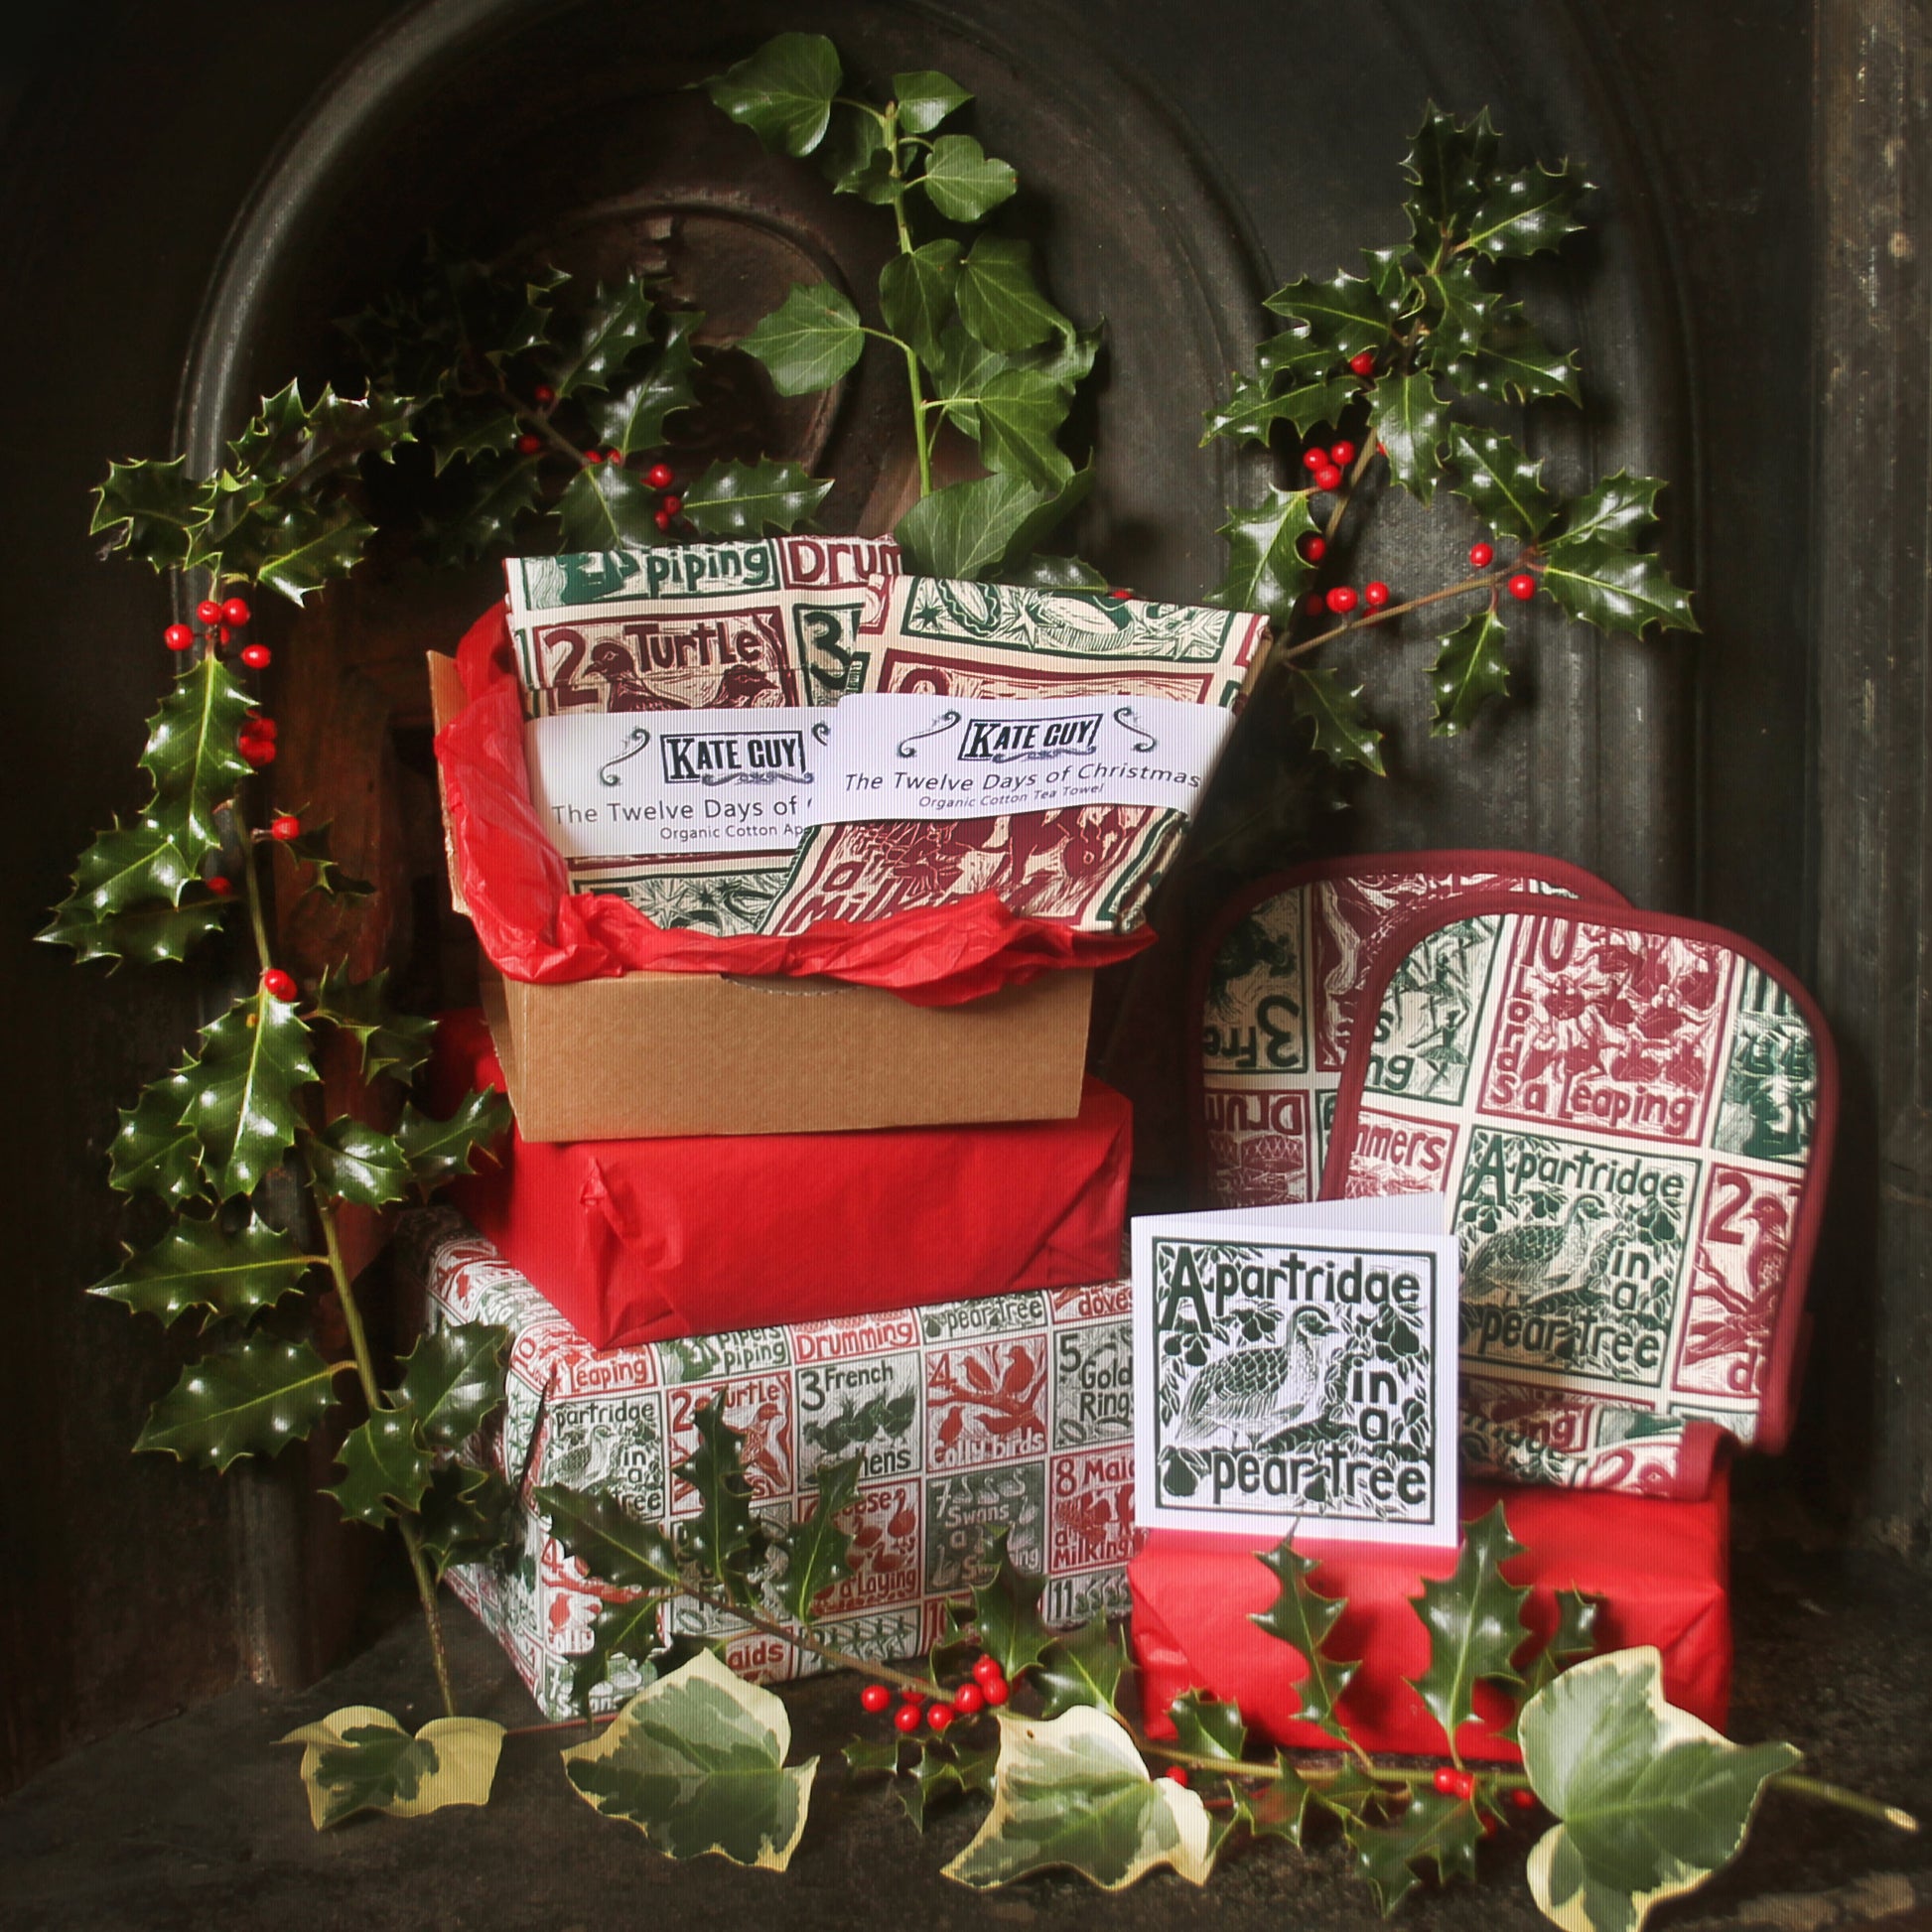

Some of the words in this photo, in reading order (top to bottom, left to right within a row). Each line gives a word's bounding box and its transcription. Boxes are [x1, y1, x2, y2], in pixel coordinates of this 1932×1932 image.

[647, 542, 769, 599] piping
[543, 628, 600, 707] 2
[803, 612, 852, 690] 3
[666, 739, 742, 780] KATE
[748, 737, 796, 768] GUY
[965, 722, 1037, 759] KATE
[1043, 719, 1097, 747] GUY
[846, 773, 884, 791] The
[894, 773, 974, 792] Twelve
[983, 772, 1036, 790] Days
[1046, 764, 1070, 784] of
[1079, 763, 1201, 788] Christmas
[919, 795, 976, 810] Organic
[980, 792, 1028, 807] Cotton
[1034, 790, 1059, 801] Tea
[1062, 783, 1104, 798] Towel
[552, 805, 598, 824] The
[608, 798, 694, 822] Twelve
[705, 798, 763, 822] Days
[773, 795, 796, 815] of
[660, 826, 720, 842] Organic
[726, 824, 777, 838] Cotton
[1560, 1072, 1695, 1136] Leaping
[1461, 1135, 1507, 1207] A
[1517, 1148, 1685, 1199] partridge
[1708, 1172, 1751, 1246] 2
[1610, 1240, 1650, 1280] in
[1160, 1246, 1213, 1334] A
[1215, 1252, 1421, 1316] partridge
[1612, 1282, 1639, 1311] a
[946, 1307, 991, 1337] pear
[997, 1295, 1043, 1323] tree
[1478, 1303, 1568, 1354] pear
[1577, 1311, 1660, 1368] tree
[724, 1341, 786, 1375] piping
[796, 1322, 912, 1359] Drumming
[1059, 1333, 1081, 1373] 5
[800, 1371, 825, 1411] 3
[826, 1360, 894, 1391] French
[928, 1353, 958, 1391] 4
[1081, 1356, 1133, 1390] Gold
[1352, 1357, 1398, 1405] in
[555, 1400, 655, 1438] partridge
[671, 1391, 693, 1434] 2
[1079, 1392, 1133, 1422] Ring
[1359, 1406, 1389, 1443] a
[623, 1441, 646, 1466] in
[997, 1429, 1044, 1457] birds
[627, 1467, 643, 1484] a
[1056, 1458, 1076, 1497] 8
[1212, 1450, 1309, 1505] pear
[1326, 1446, 1427, 1505] tree
[1054, 1536, 1129, 1569] Milking
